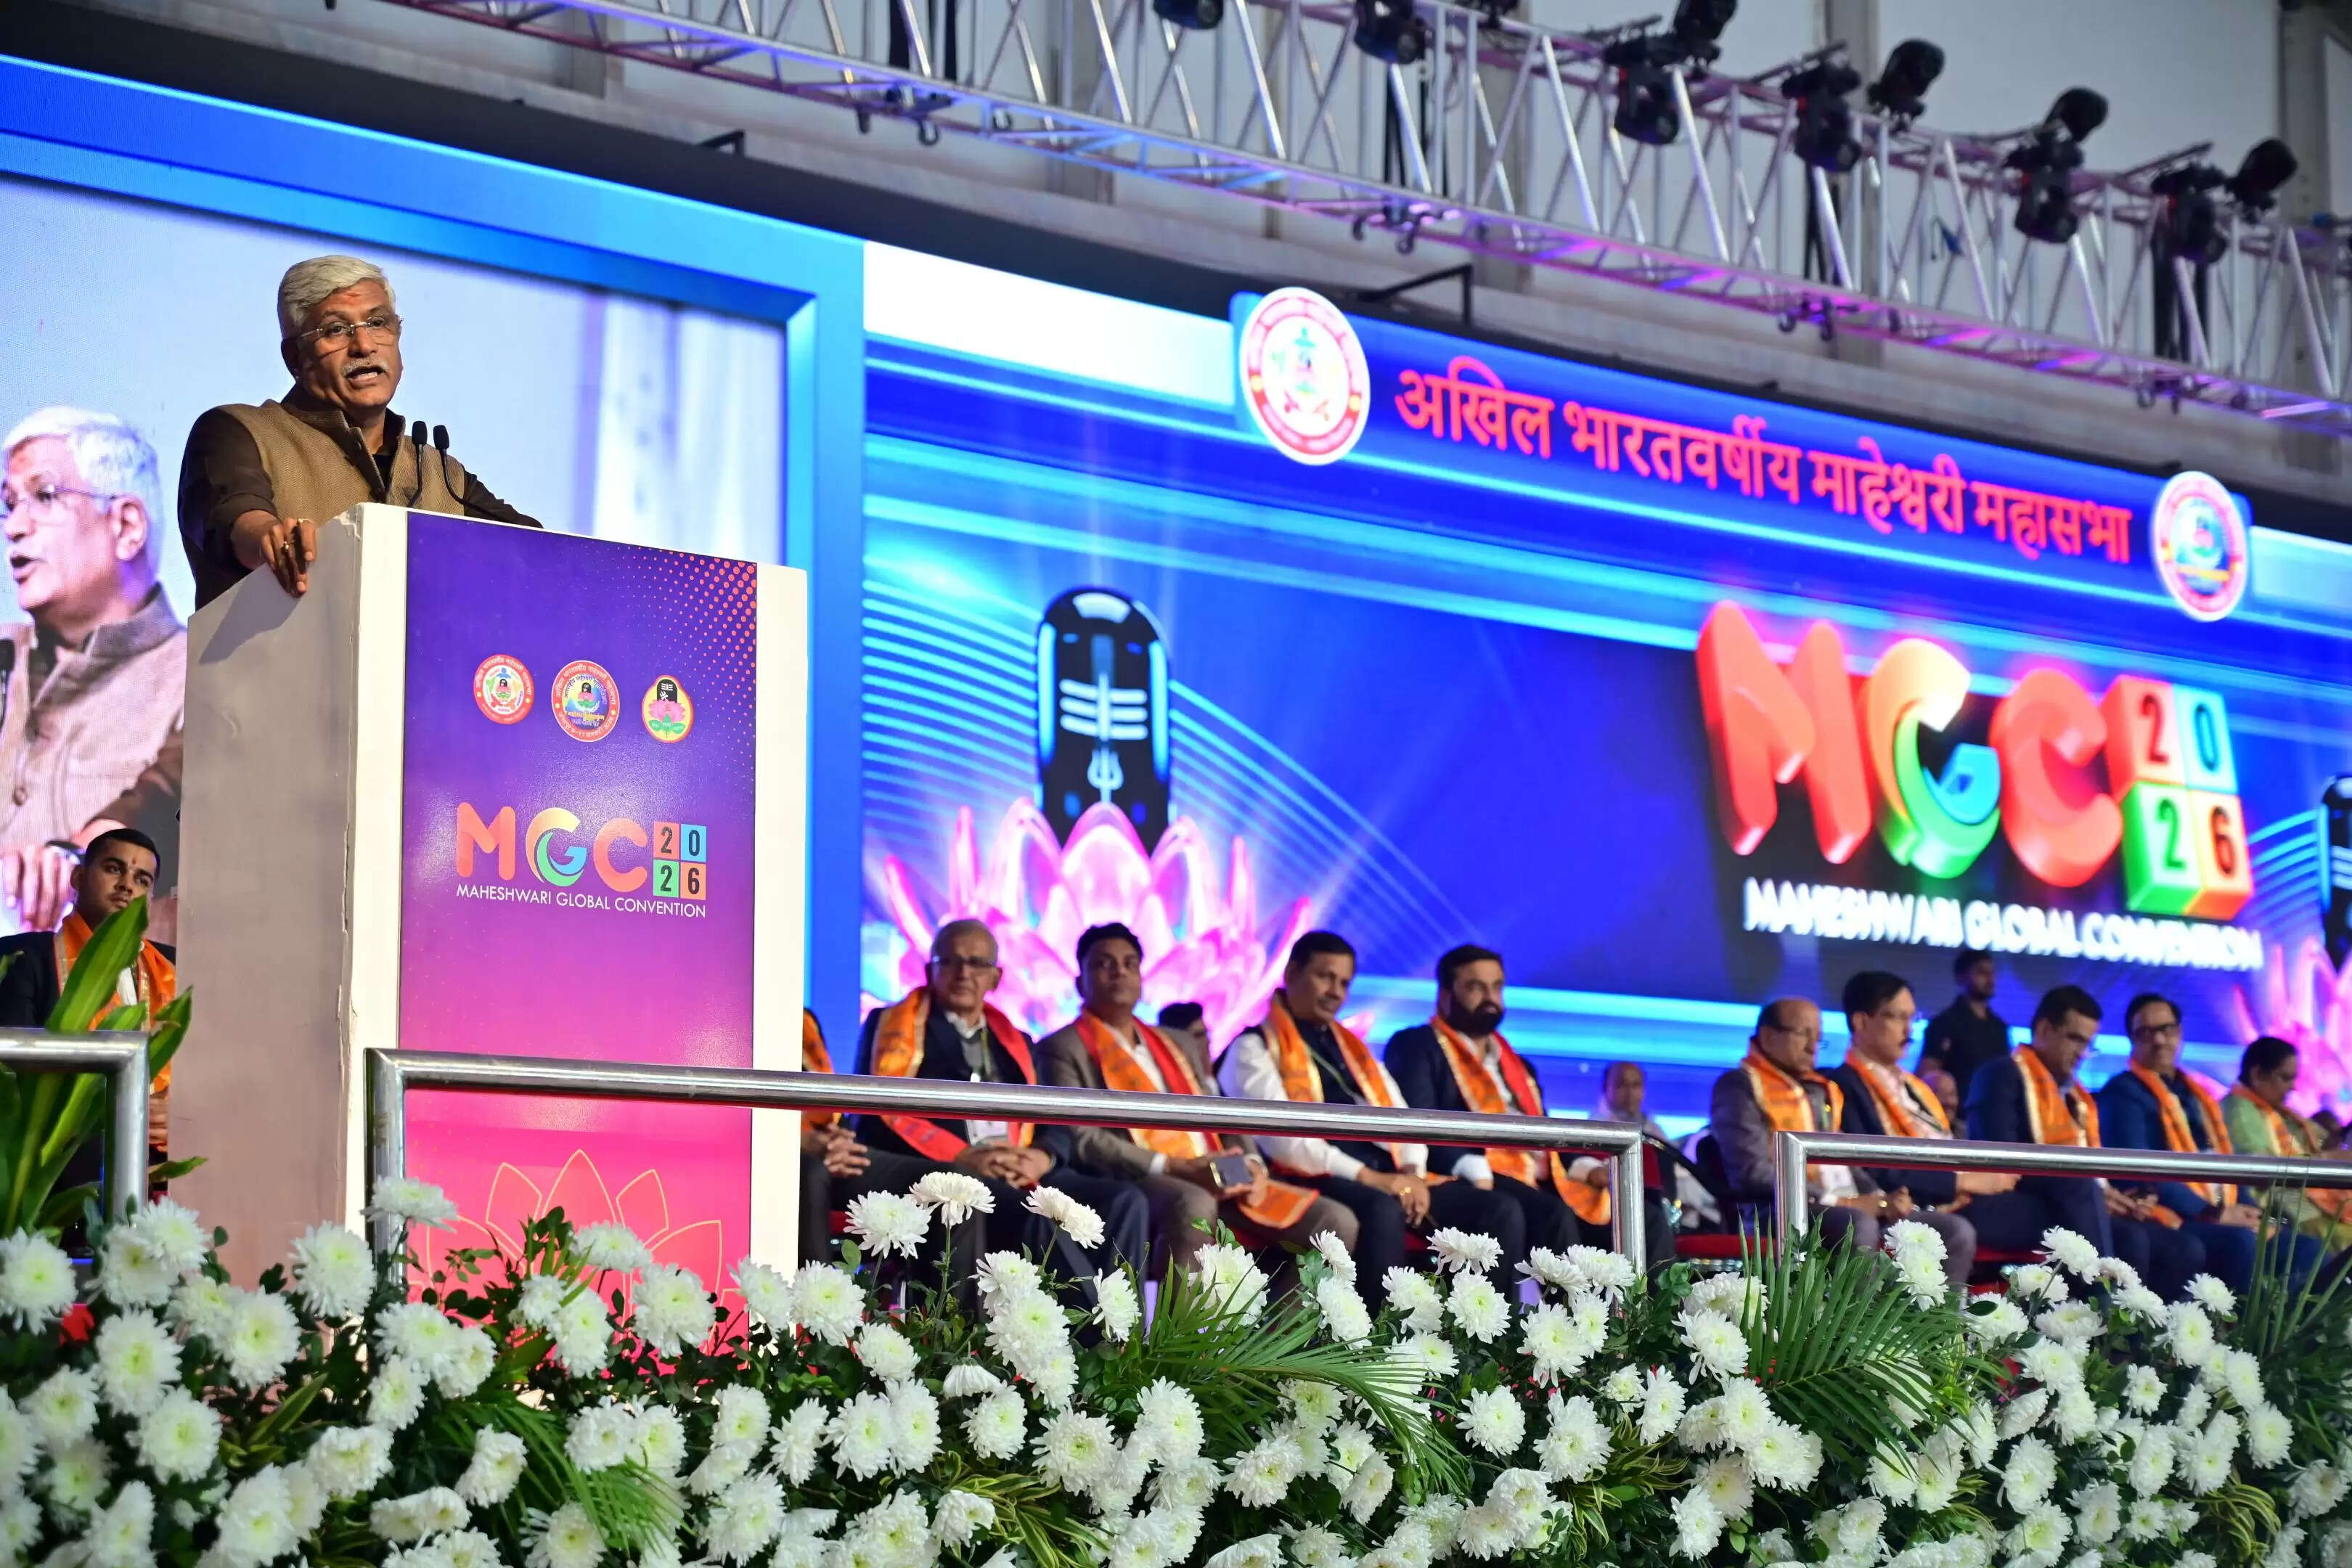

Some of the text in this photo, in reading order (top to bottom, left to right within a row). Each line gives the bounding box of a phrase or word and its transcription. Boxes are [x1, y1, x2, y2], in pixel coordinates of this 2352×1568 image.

[1395, 356, 1555, 459] अखिल
[1563, 400, 1803, 505] भारतवर्षीय
[1808, 436, 1967, 534] माहेश्वरी
[1969, 481, 2133, 563] महासभा
[1696, 600, 2123, 887] MGC
[456, 802, 648, 892] MGC
[456, 883, 706, 918] MAHESHWARI GLOBAL CONVENTION
[1964, 899, 2081, 958] GLOBAL
